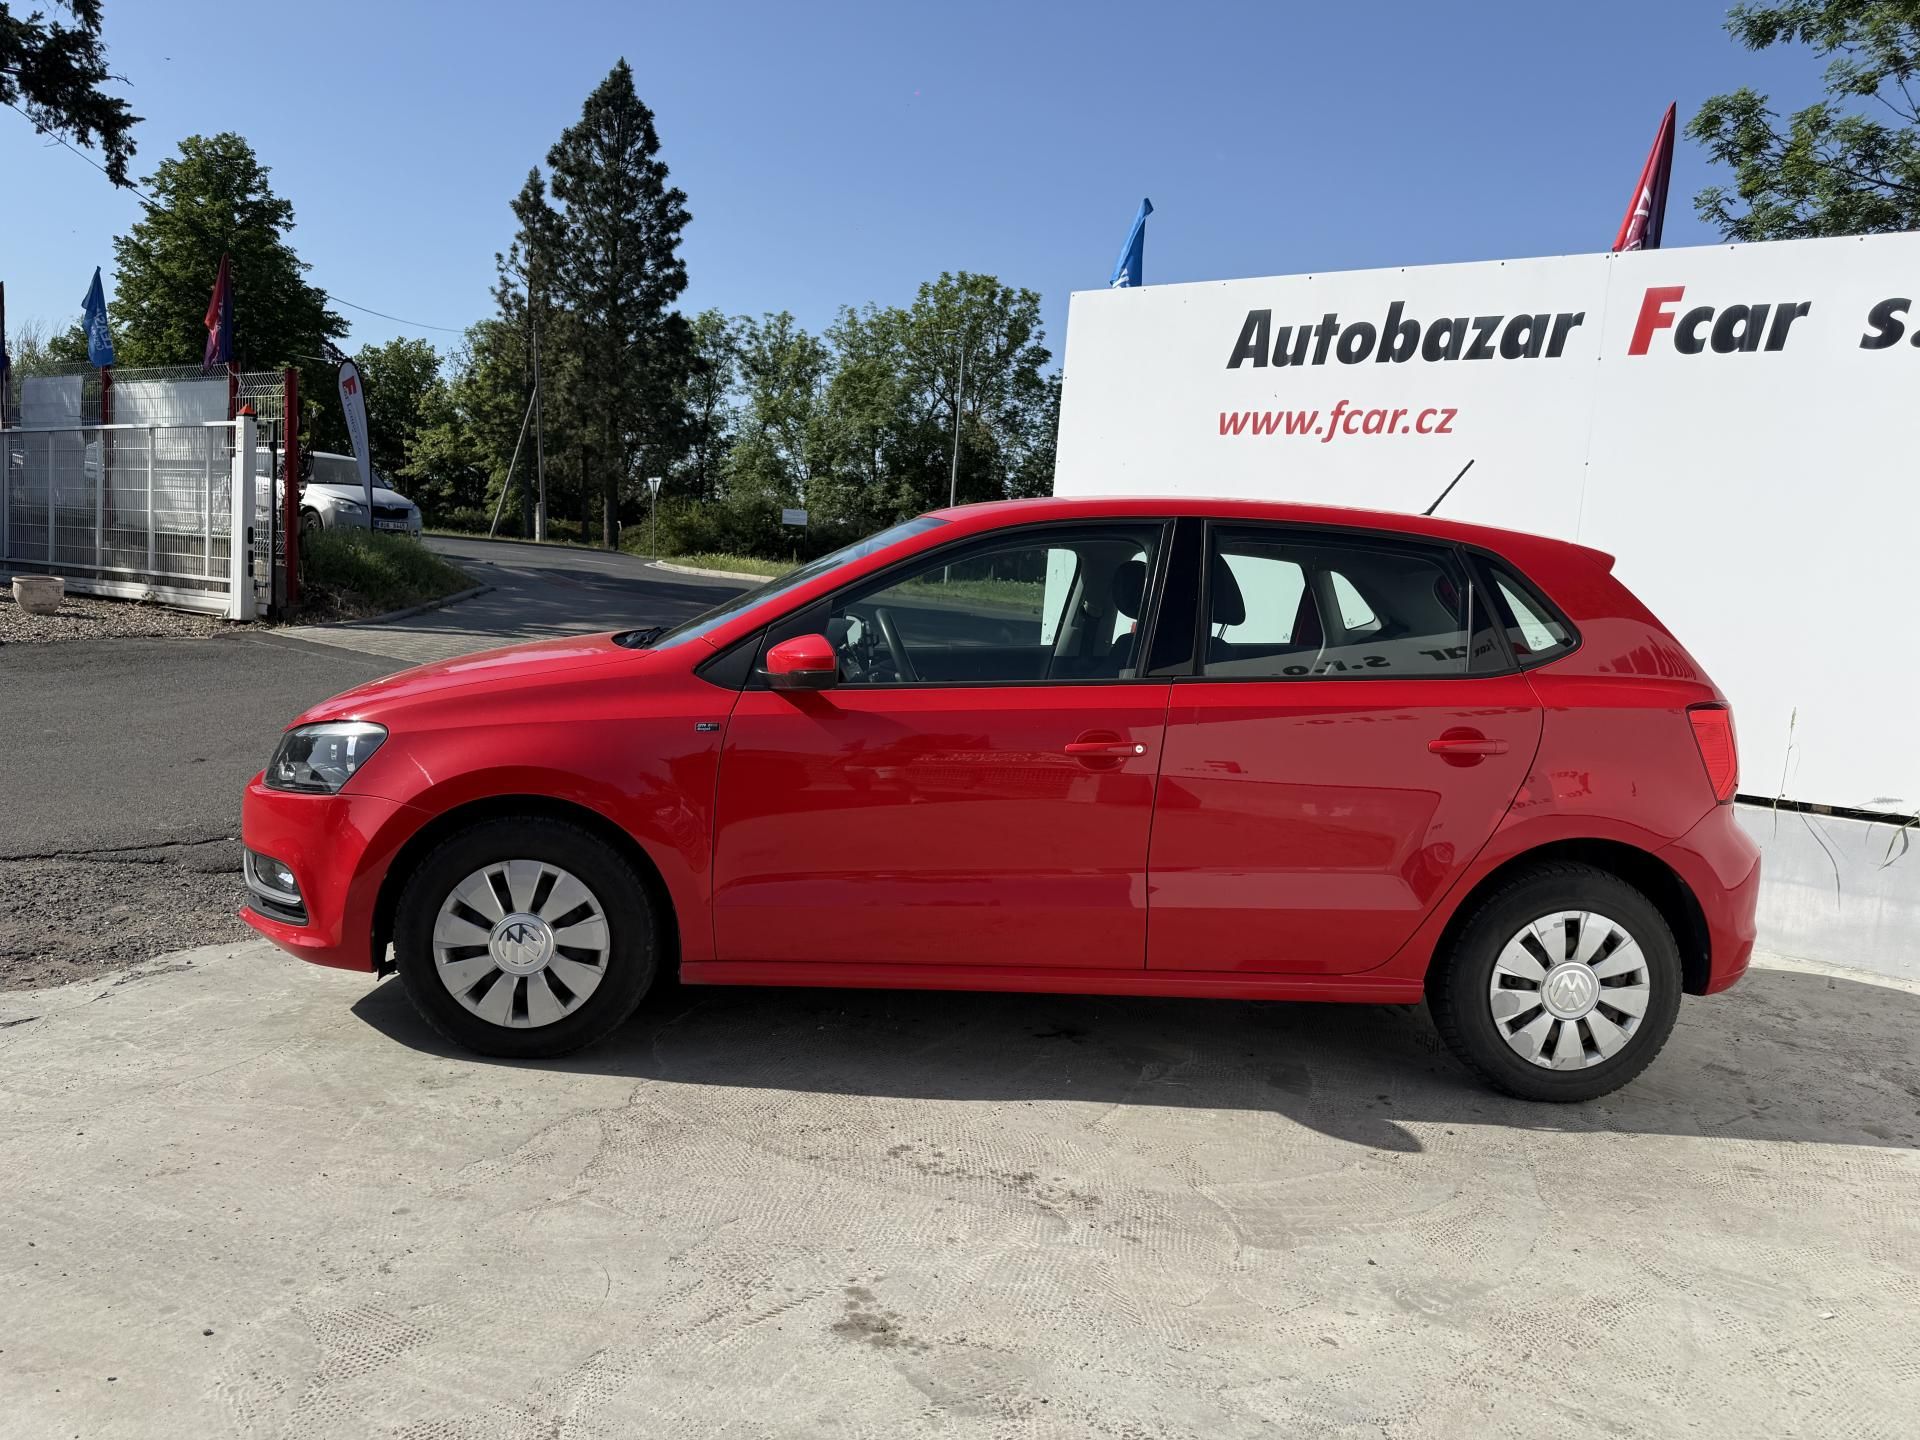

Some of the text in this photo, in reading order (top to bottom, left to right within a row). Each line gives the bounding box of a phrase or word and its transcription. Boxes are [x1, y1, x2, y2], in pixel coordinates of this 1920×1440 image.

[1227, 301, 1585, 369] Autobazar
[1628, 286, 1811, 355] Fcar
[1219, 400, 1457, 443] www.fcar.cz
